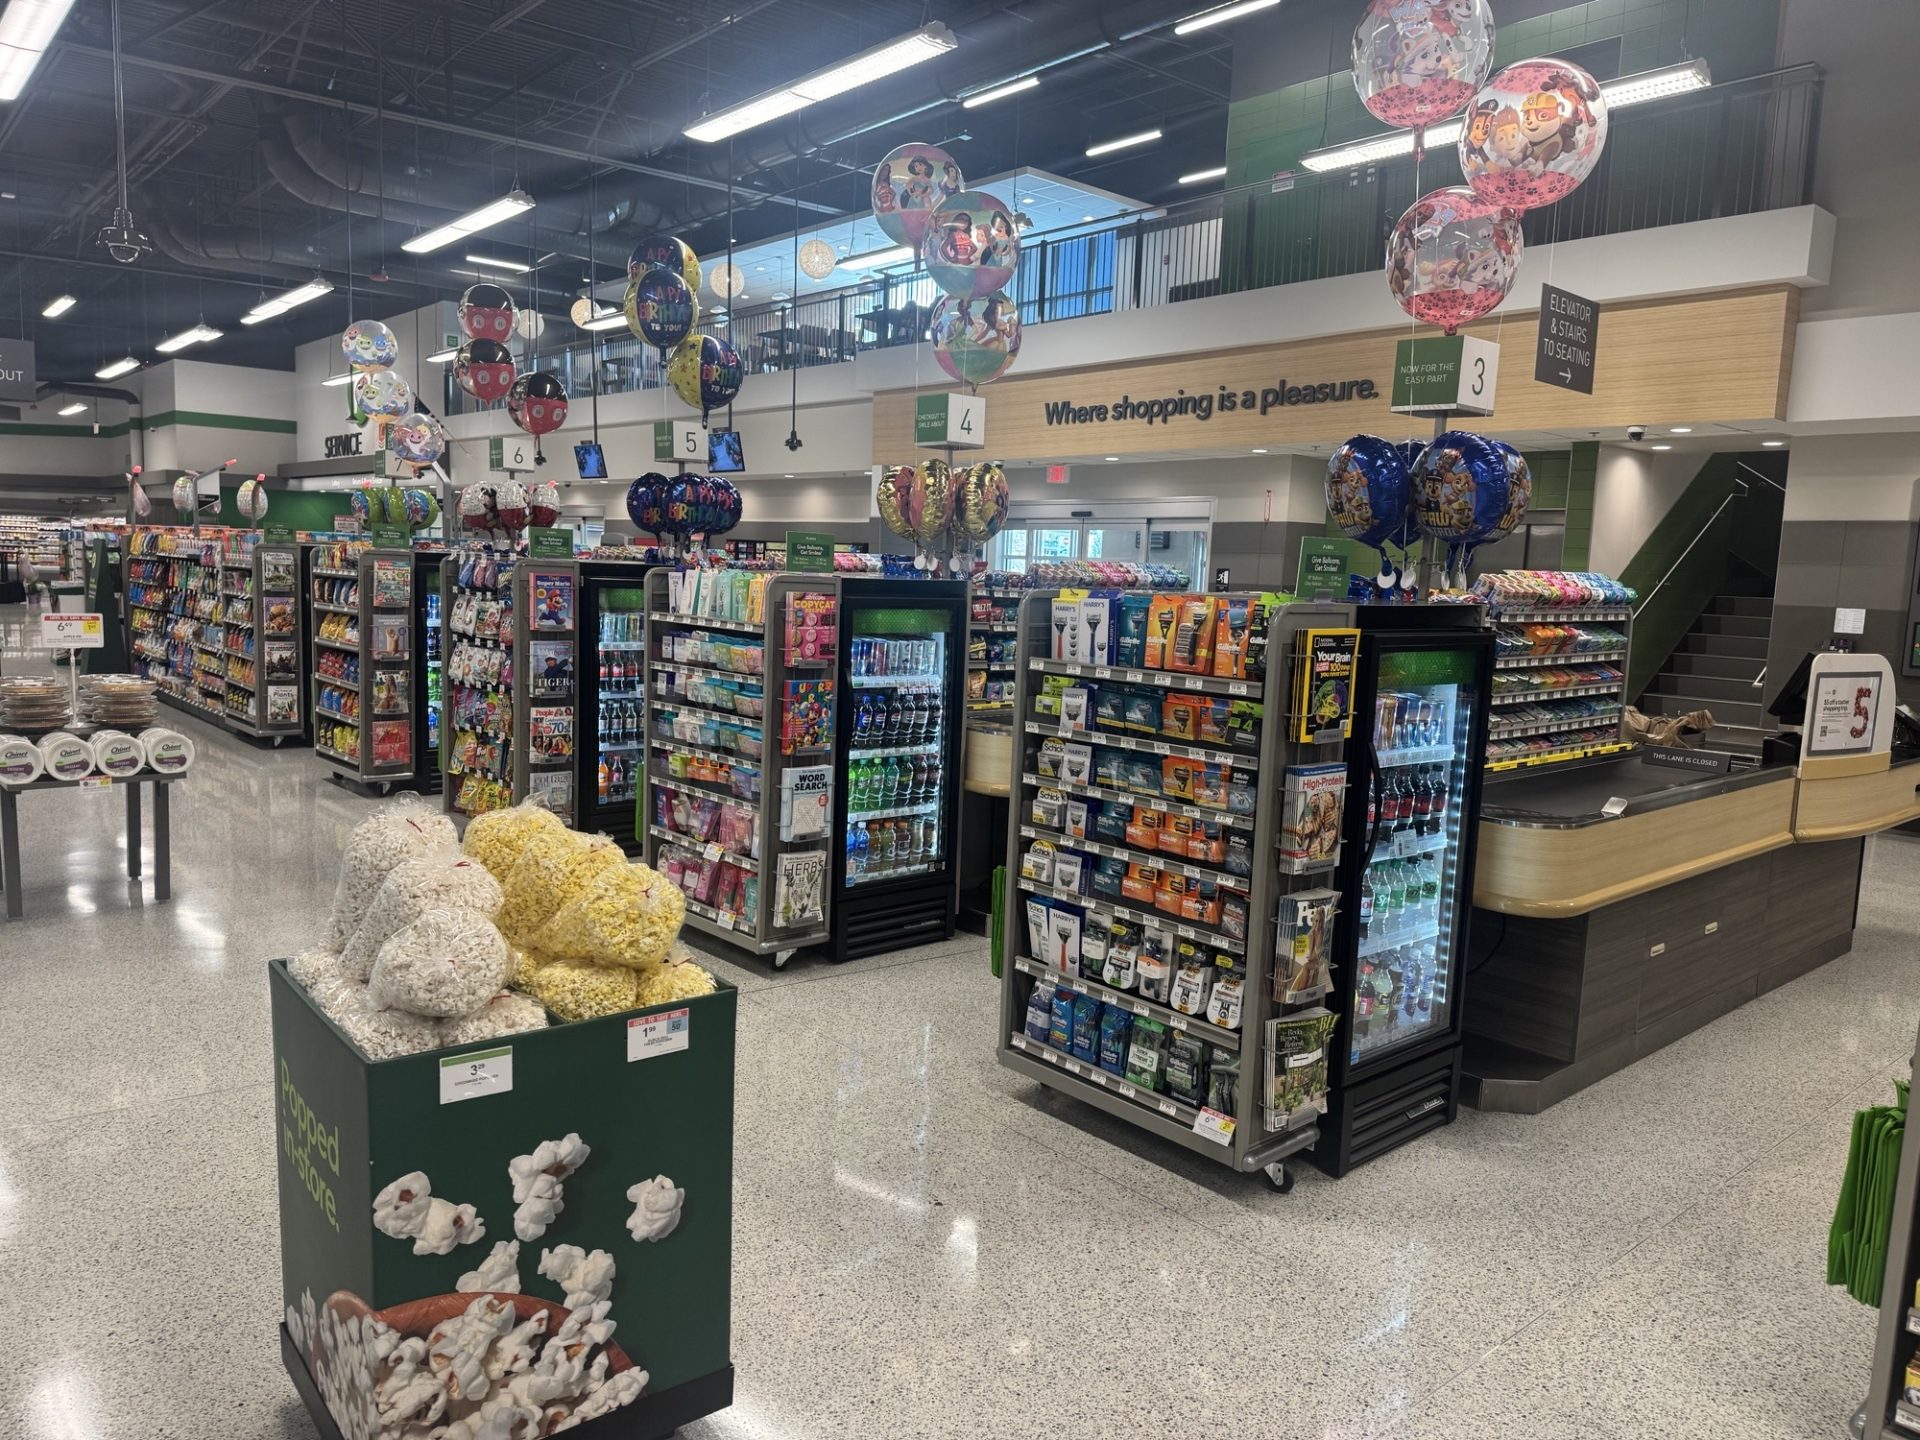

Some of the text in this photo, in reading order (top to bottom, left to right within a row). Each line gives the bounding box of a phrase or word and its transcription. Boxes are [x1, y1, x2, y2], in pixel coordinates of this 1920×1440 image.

[1550, 294, 1592, 323] ELEVATOR
[1550, 319, 1588, 344] & STAIRS
[1543, 338, 1591, 367] TO SEATING
[1400, 362, 1455, 374] NOW FOR THE
[1405, 374, 1448, 385] EASY PART
[1472, 357, 1485, 396] 3
[1045, 378, 1380, 426] Where shopping is a pleasure.
[961, 408, 973, 435] 4
[325, 433, 362, 458] SERVICE
[686, 432, 697, 453] 5
[514, 447, 524, 464] 6
[394, 457, 403, 472] 7
[794, 601, 836, 609] COPYCAT
[1217, 643, 1241, 652] Gillette
[1317, 651, 1351, 663] Your Brain
[1330, 663, 1340, 671] 100
[538, 678, 570, 687] TIGER
[535, 709, 554, 717] People
[1850, 686, 1872, 739] 5
[1243, 720, 1253, 732] 4
[60, 748, 81, 758] Chinet
[111, 745, 131, 754] Chinet
[162, 743, 182, 751] Chinet
[1044, 743, 1064, 752] Schick
[5, 751, 28, 759] Chinet
[1653, 752, 1667, 760] THIS
[1693, 758, 1718, 767] CLOSED
[799, 774, 826, 782] WORD
[1302, 776, 1345, 790] High-Protein
[795, 782, 828, 791] SEARCH
[1040, 791, 1060, 802] Schick
[1032, 846, 1050, 857] Schick
[784, 860, 824, 876] HERBS
[1053, 912, 1077, 924] HARRY'S
[281, 1056, 340, 1176] Popped
[282, 1107, 340, 1233] in-store.
